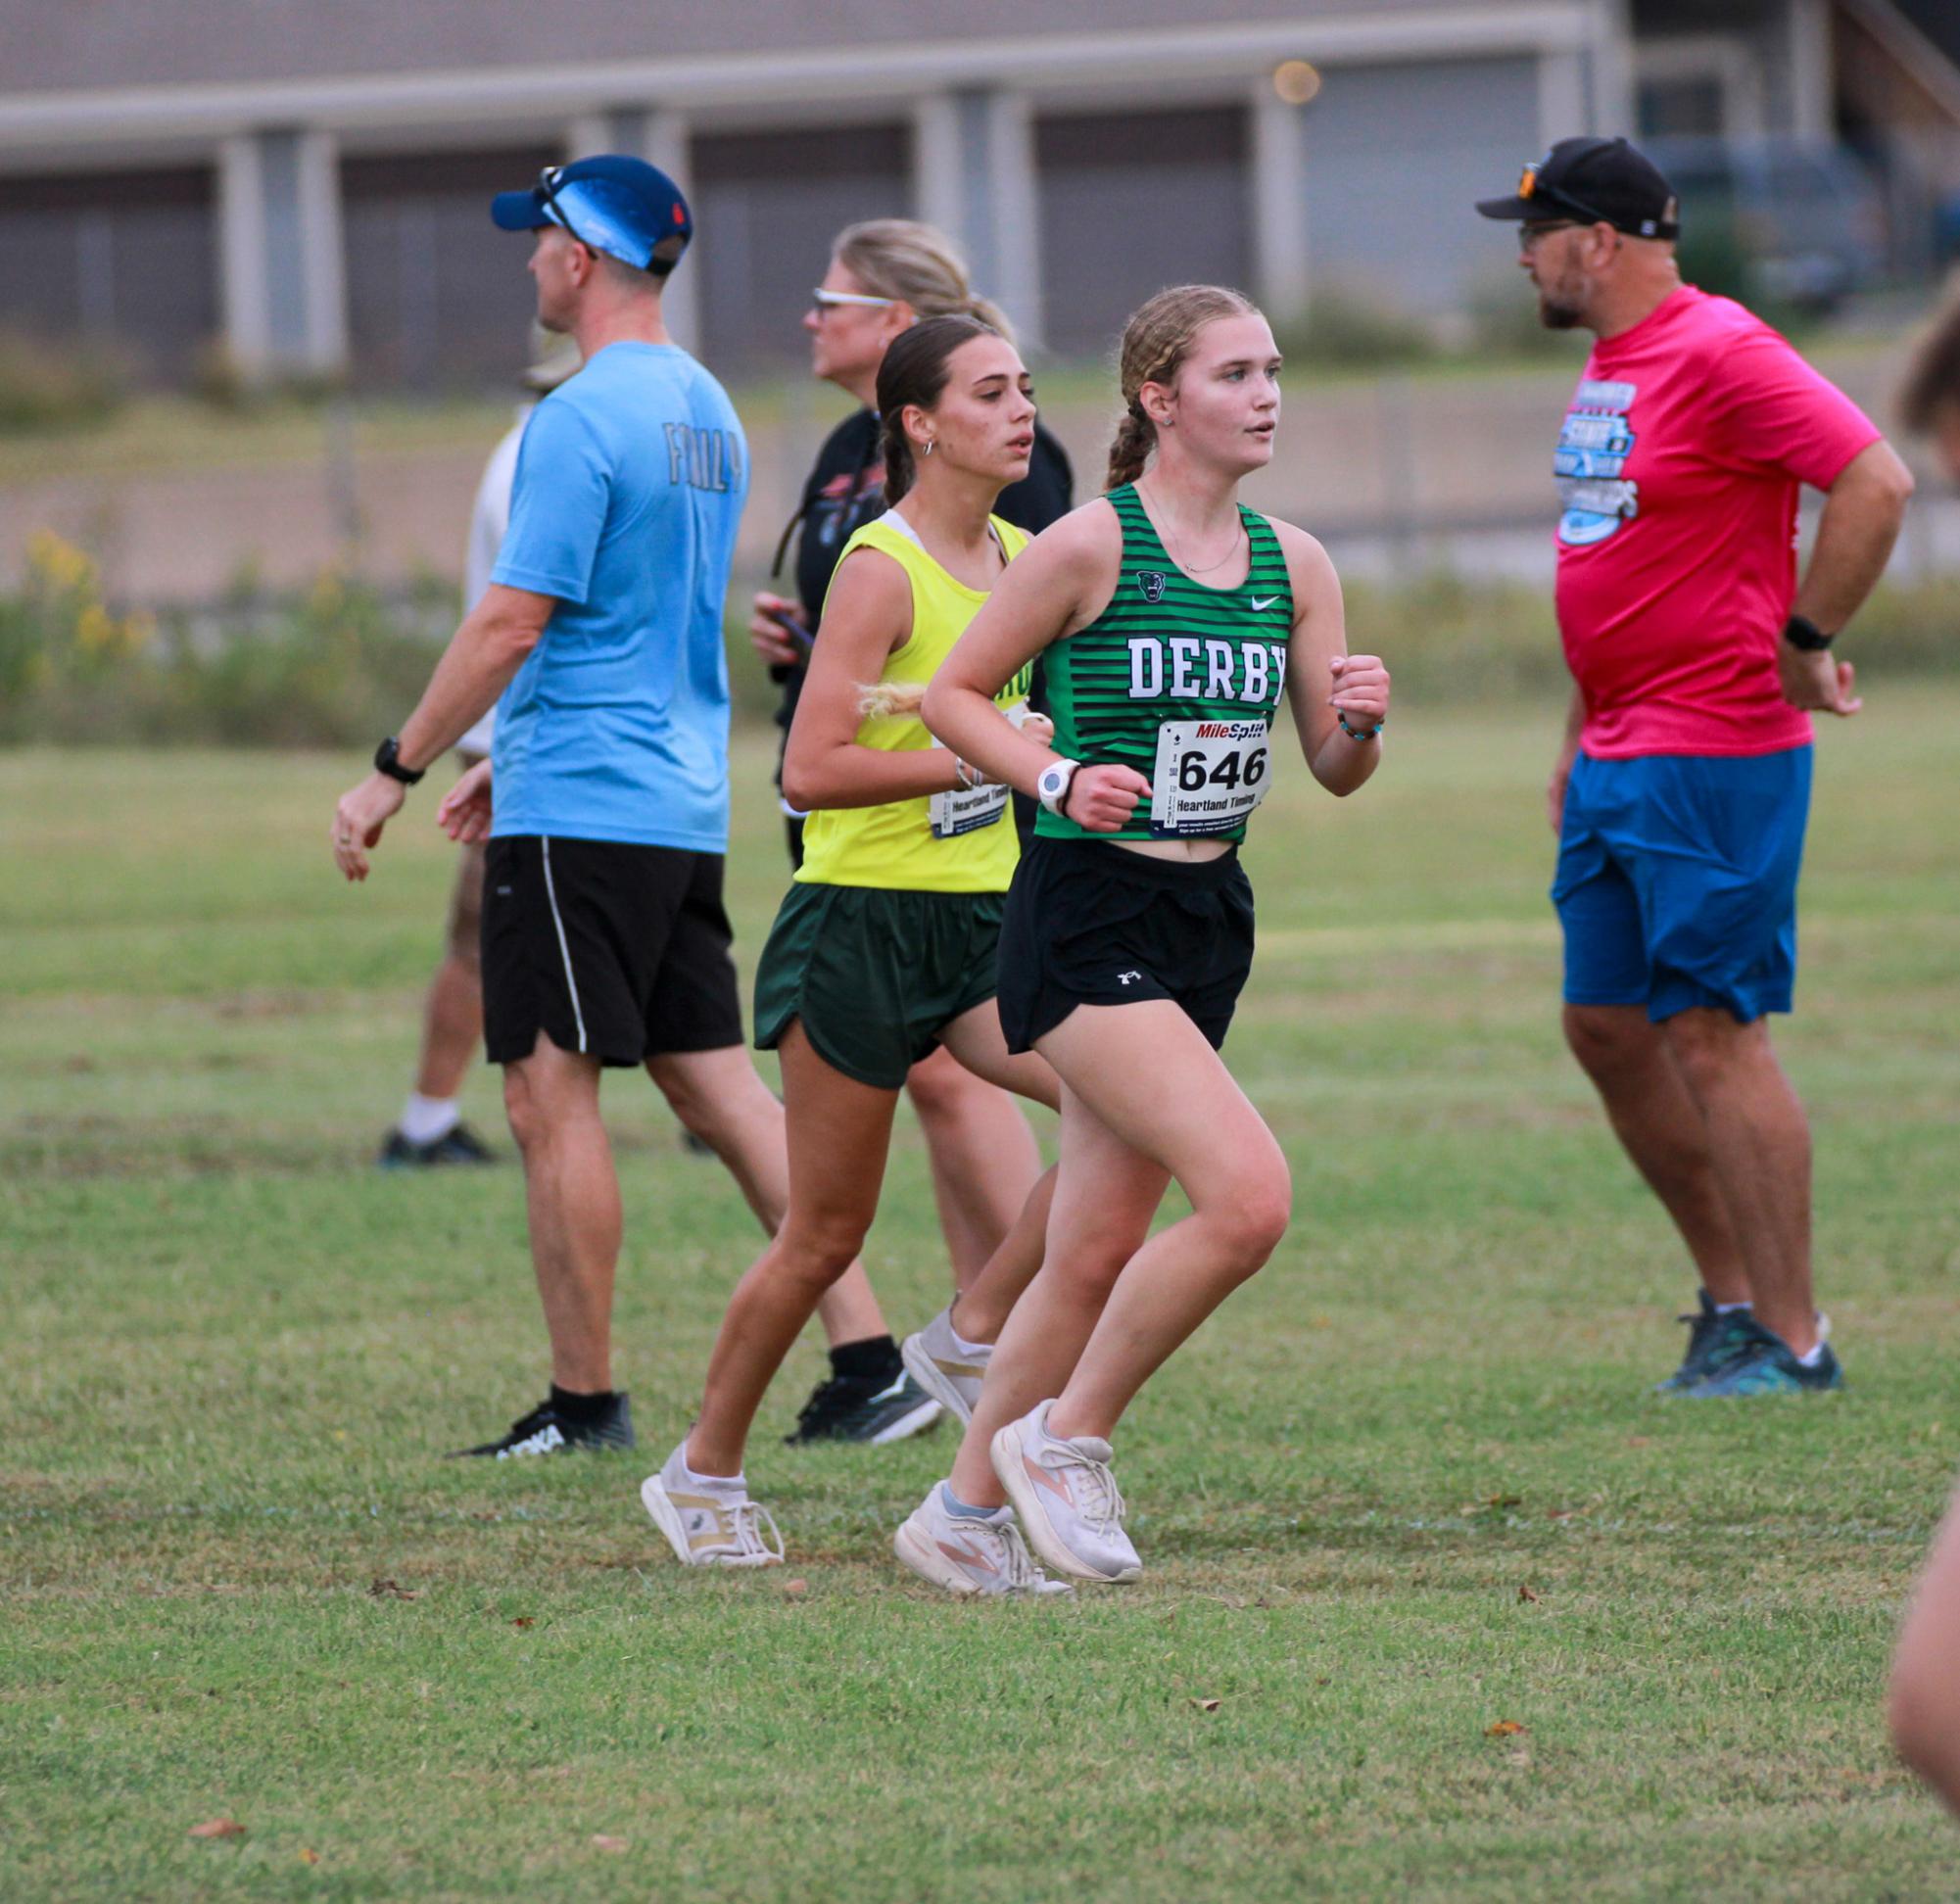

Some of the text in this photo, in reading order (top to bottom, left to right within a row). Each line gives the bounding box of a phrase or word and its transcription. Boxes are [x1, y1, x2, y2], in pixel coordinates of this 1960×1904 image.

[1127, 637, 1286, 706] DERBY
[1196, 723, 1265, 741] MileSplit
[1179, 747, 1267, 791] 646
[1177, 798, 1228, 812] Heartland
